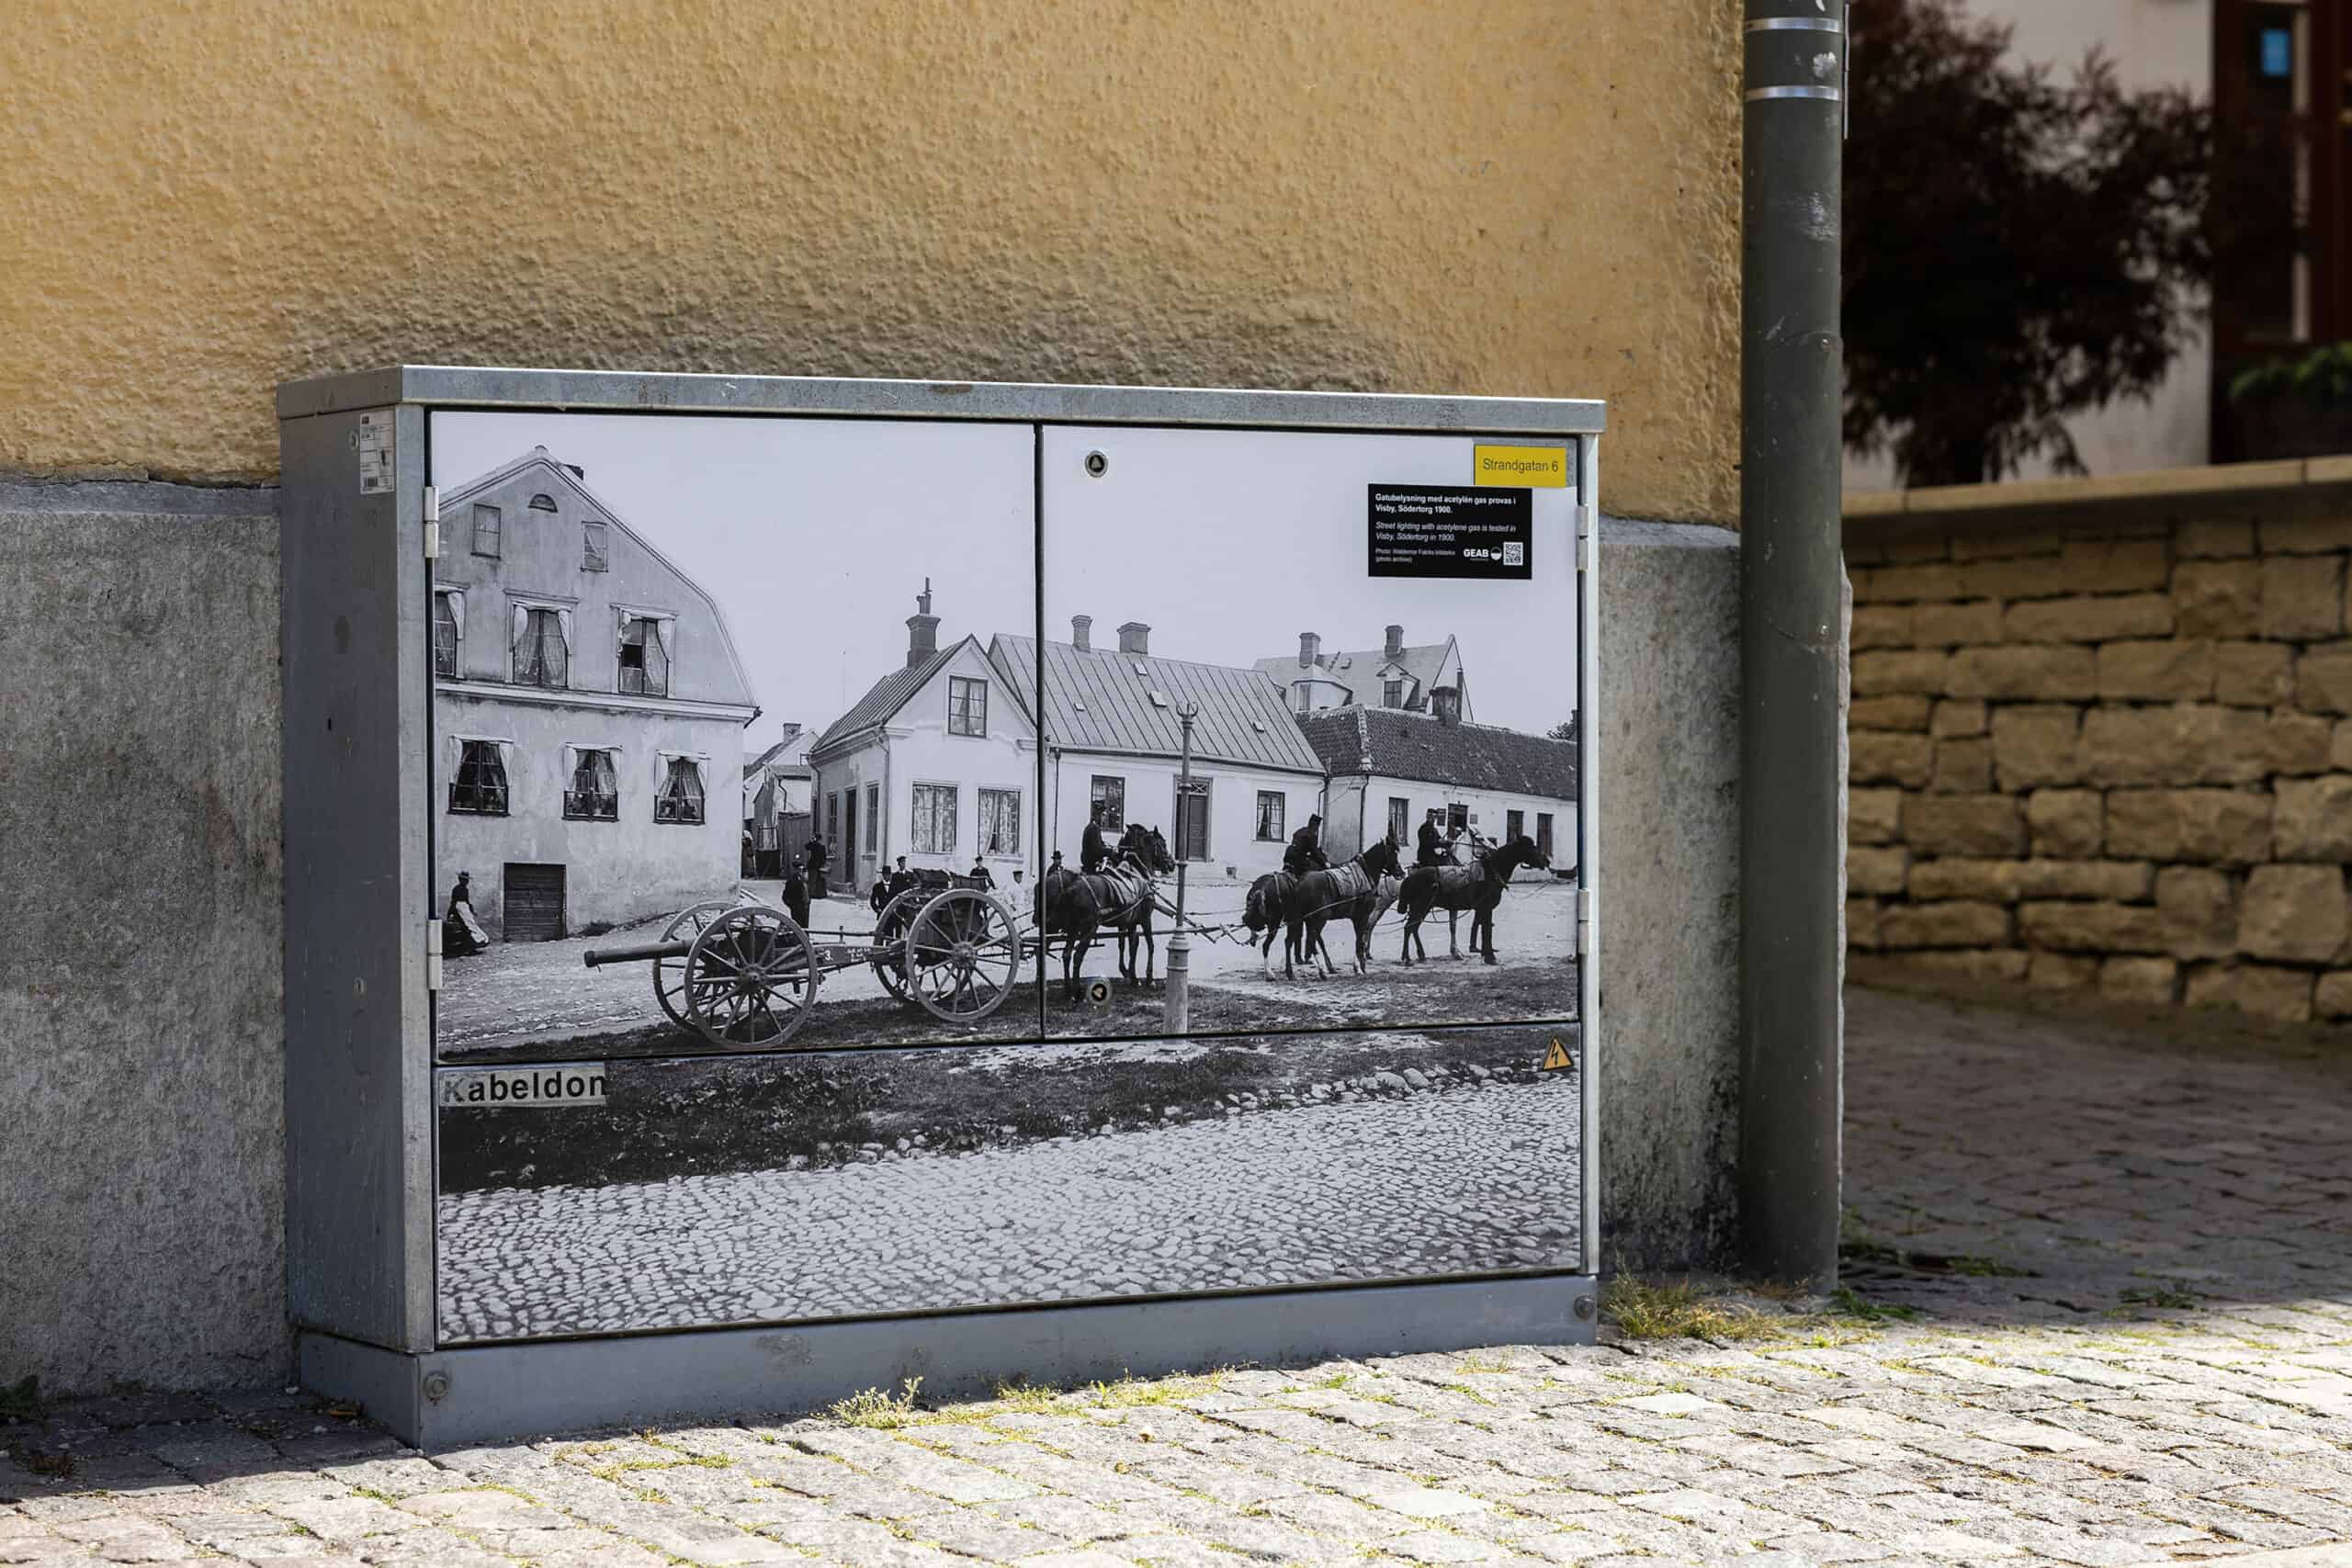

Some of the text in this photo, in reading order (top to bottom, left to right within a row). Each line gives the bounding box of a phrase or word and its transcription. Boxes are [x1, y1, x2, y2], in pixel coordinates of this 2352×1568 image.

[1483, 457, 1559, 474] Strandgatan 6
[1374, 492, 1426, 504] Gatubelysning
[1427, 495, 1443, 503] med
[1488, 498, 1512, 506] provas
[1397, 504, 1433, 514] Södertorg
[1375, 521, 1396, 530] Street
[1396, 522, 1420, 532] lighting
[1421, 523, 1435, 531] with
[1436, 523, 1467, 533] acetylene
[1468, 525, 1480, 534] gas
[1463, 548, 1489, 558] GEAB
[444, 1071, 609, 1103] Kabeldon
